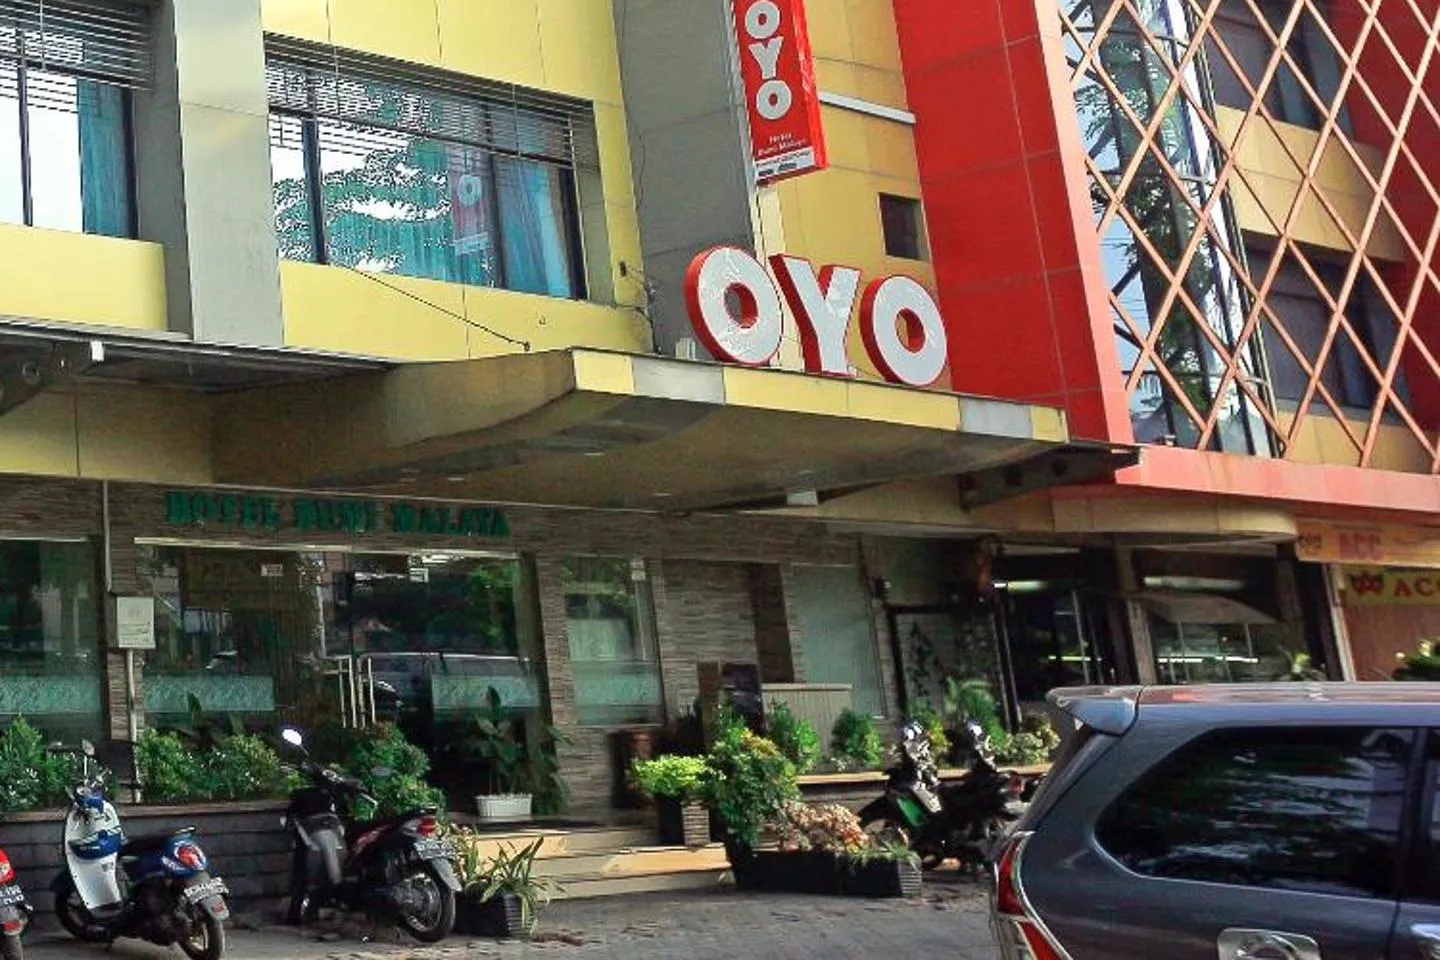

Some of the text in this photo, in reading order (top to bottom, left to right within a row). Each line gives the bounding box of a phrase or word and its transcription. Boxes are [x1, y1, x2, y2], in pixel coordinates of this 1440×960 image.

[744, 0, 792, 121] OYO
[683, 244, 948, 387] OYO
[164, 491, 279, 530] HOTEL
[391, 500, 510, 537] MALAYA
[1393, 575, 1440, 598] AC
